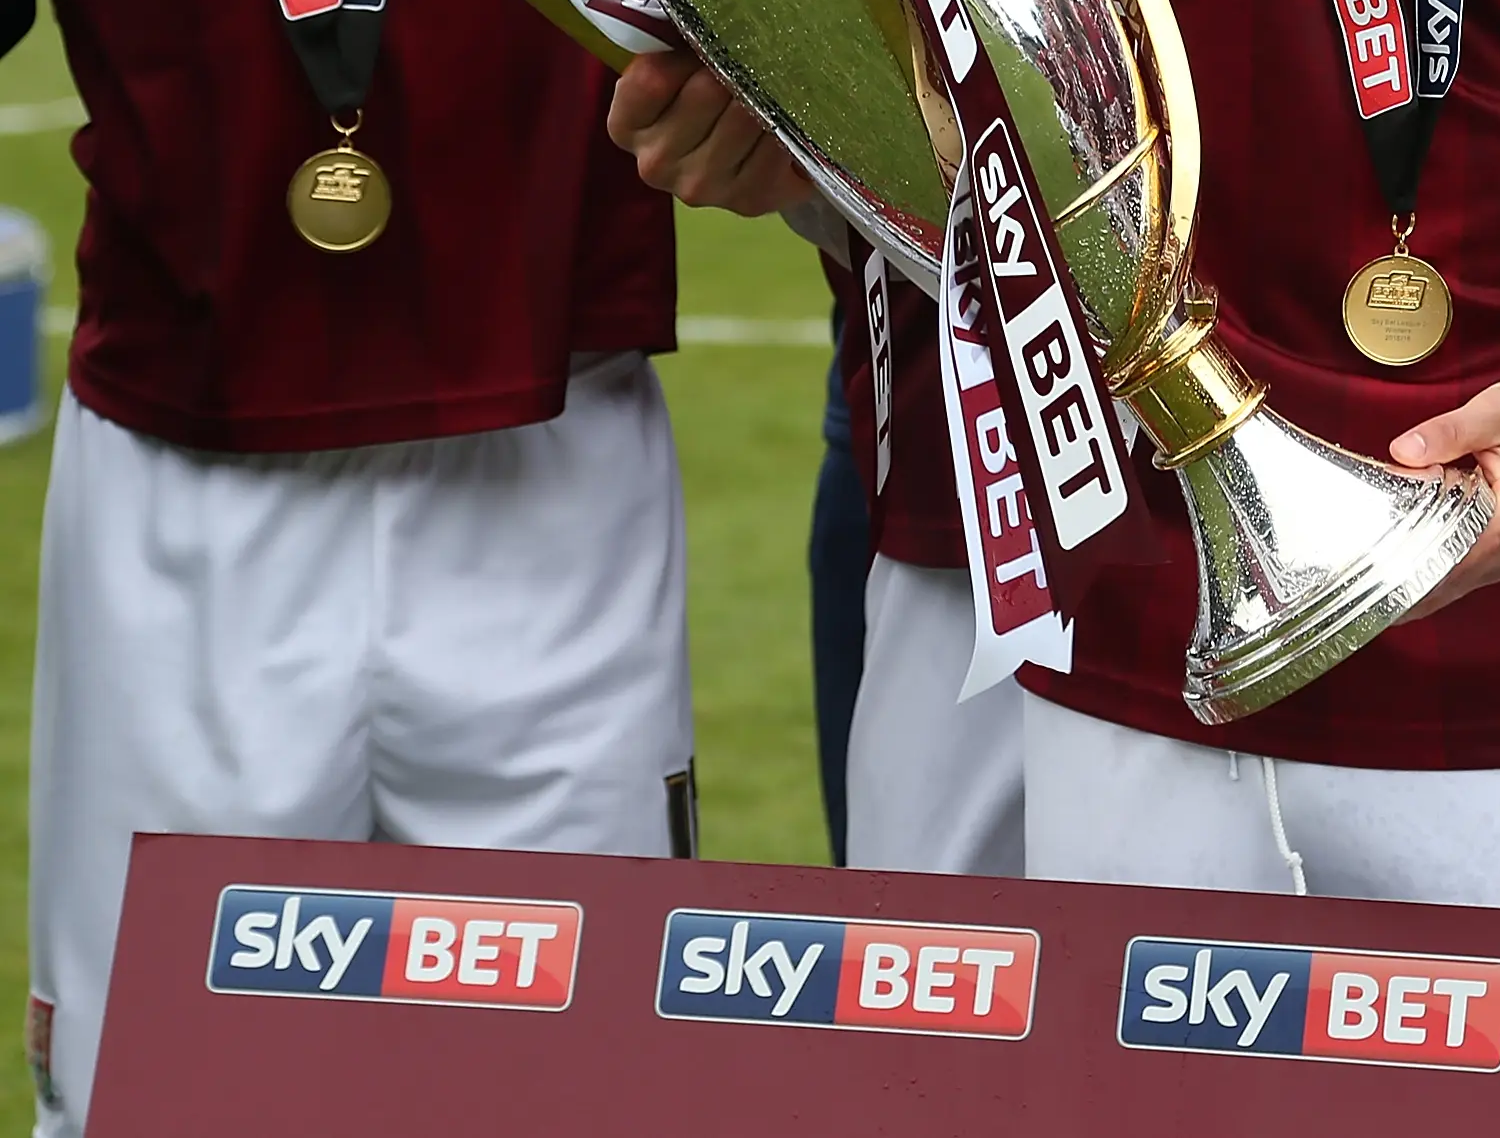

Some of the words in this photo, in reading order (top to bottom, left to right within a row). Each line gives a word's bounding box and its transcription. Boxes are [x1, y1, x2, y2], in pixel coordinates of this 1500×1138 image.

[980, 152, 1037, 276] SKY
[1022, 321, 1113, 500] BET
[231, 896, 373, 990] sky
[406, 917, 558, 988] BET
[680, 920, 825, 1016] sky
[860, 943, 1015, 1016] BET
[1142, 948, 1290, 1047] sky
[1328, 972, 1488, 1047] BET
